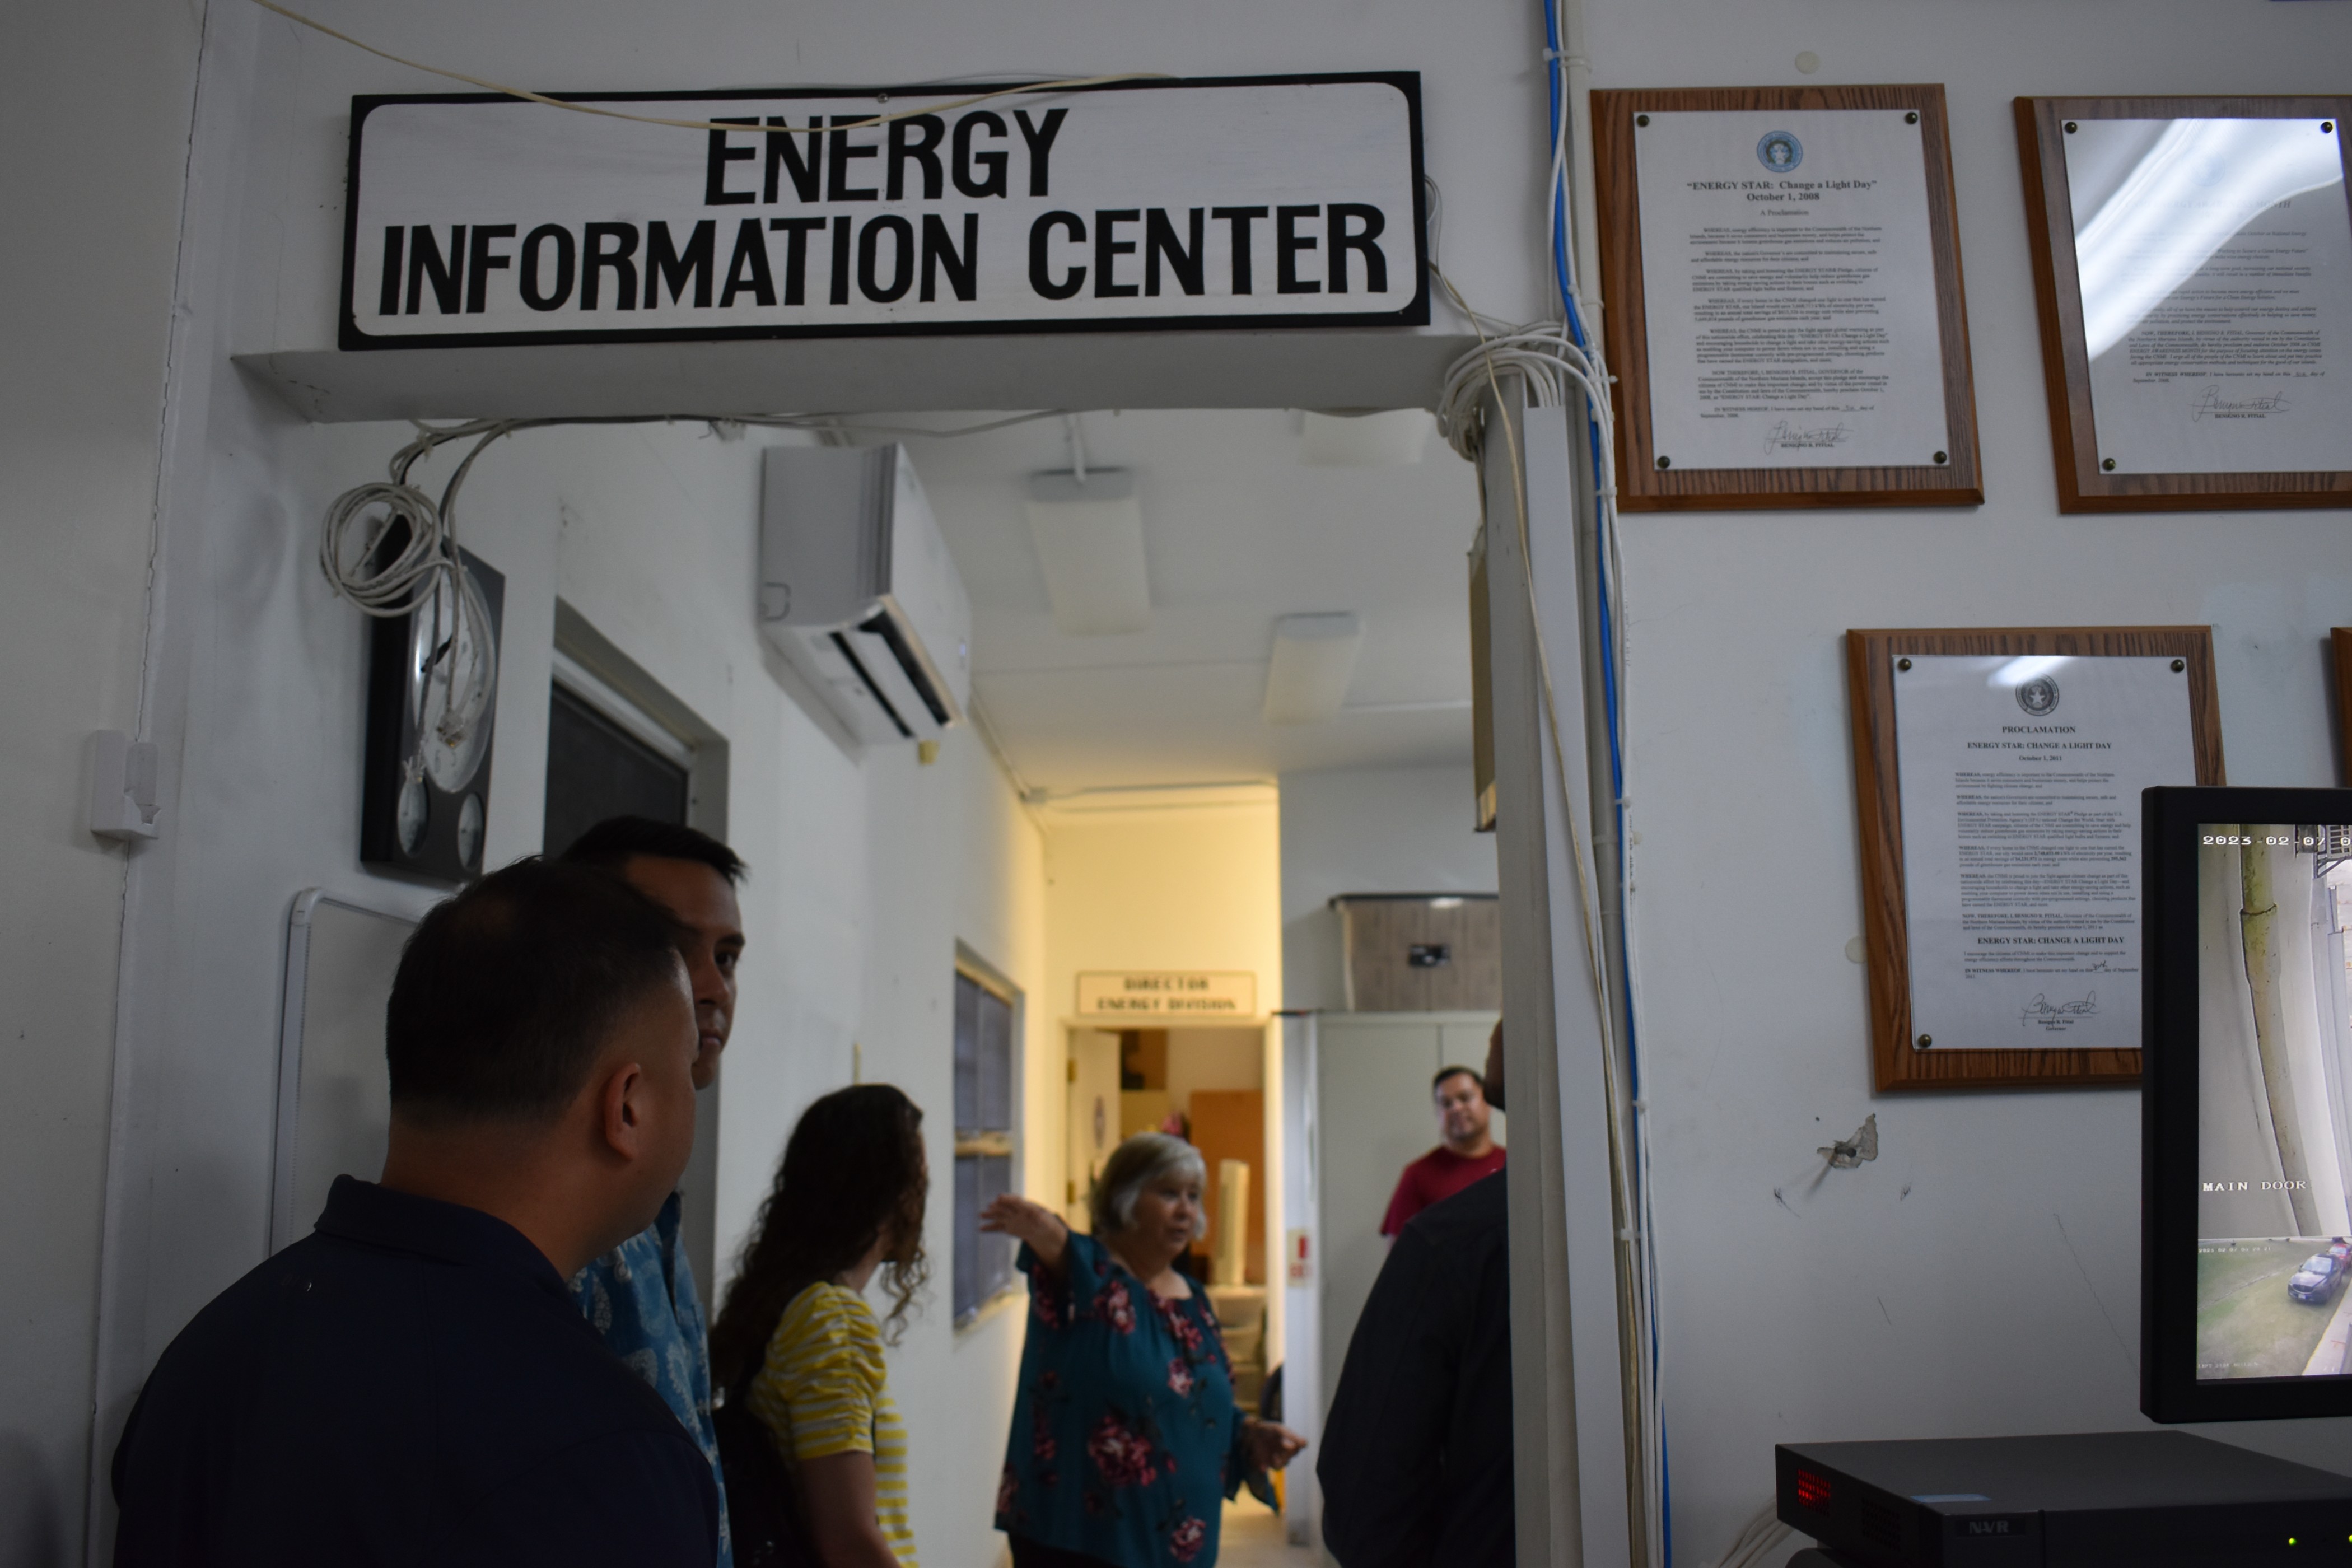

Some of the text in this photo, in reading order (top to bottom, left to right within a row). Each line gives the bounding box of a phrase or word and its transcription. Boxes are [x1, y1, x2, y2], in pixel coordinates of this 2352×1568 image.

[705, 108, 1068, 206] ENERGY
[1687, 181, 1738, 190] “ENERGY
[1741, 181, 1774, 190] STAR:
[1779, 181, 1815, 190] Change
[1825, 180, 1851, 190] Light
[1853, 180, 1877, 190] Day”
[1788, 193, 1796, 201] 1,
[379, 203, 1387, 315] INFORMATION CENTER
[2202, 835, 2326, 846] 2023-02-07
[1124, 976, 1210, 991] DIRECTOR
[1096, 997, 1235, 1010] ENERGY DIVISION
[2202, 1180, 2306, 1191] MAIN DOOR
[1969, 1520, 2009, 1534] NVR
